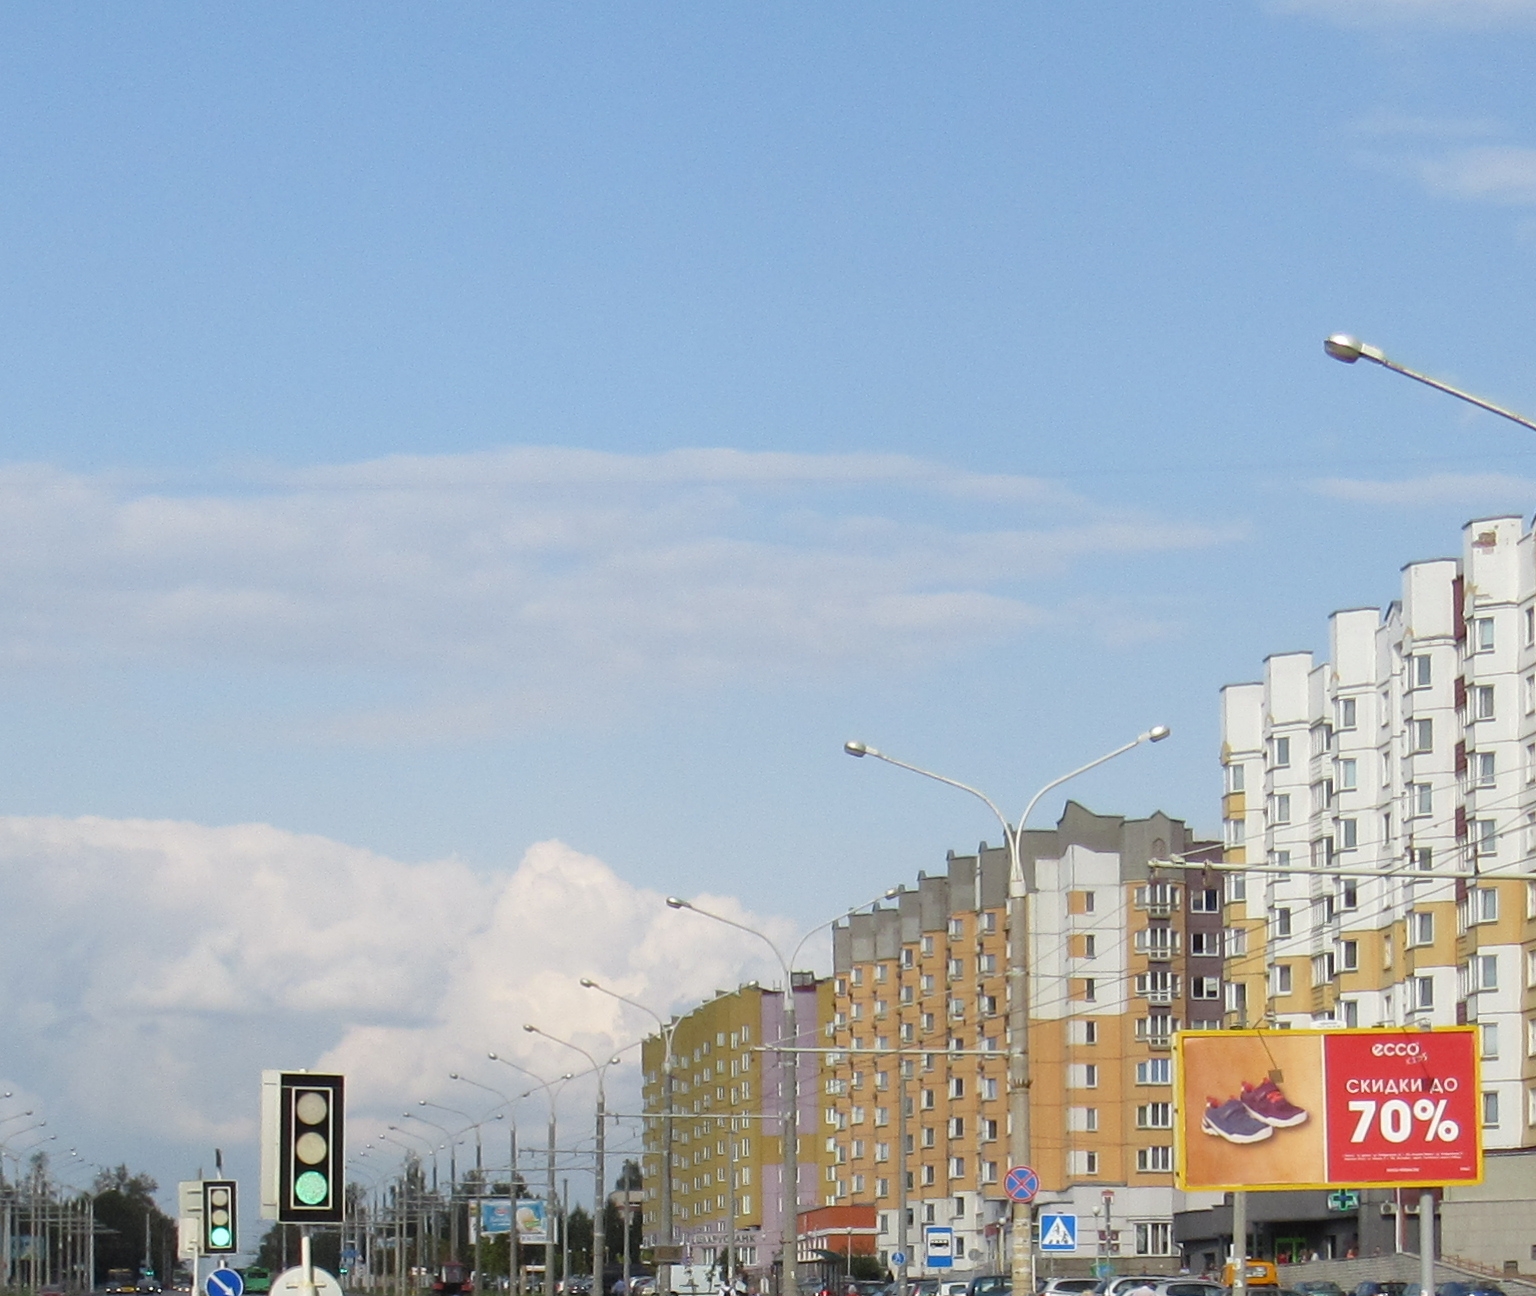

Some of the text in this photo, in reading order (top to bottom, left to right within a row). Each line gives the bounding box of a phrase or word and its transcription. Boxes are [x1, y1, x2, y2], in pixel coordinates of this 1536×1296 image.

[1372, 1042, 1420, 1057] ecco
[1346, 1077, 1458, 1094] СКИДКИ ДО
[1348, 1098, 1459, 1143] 70%
